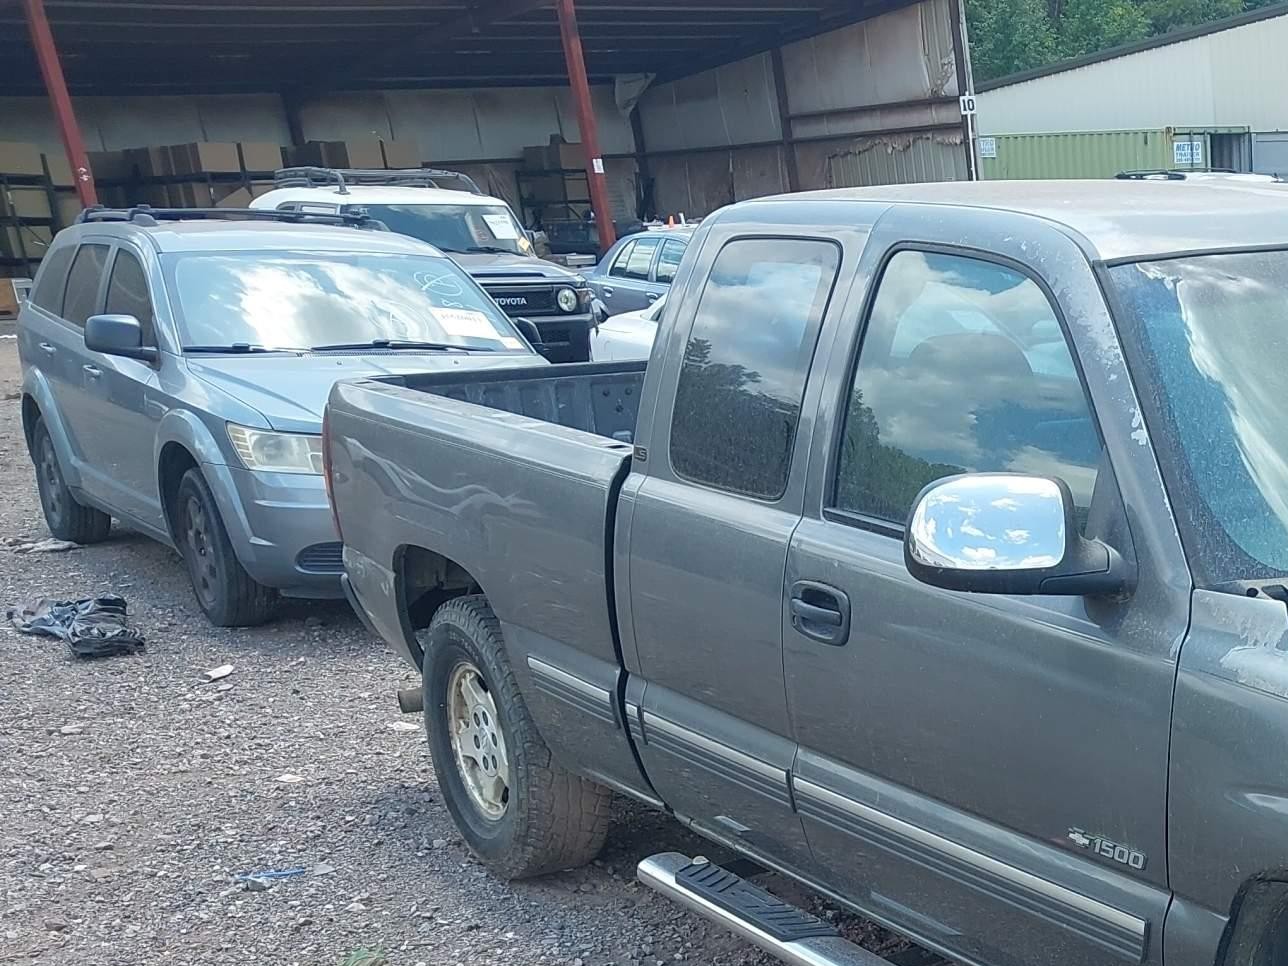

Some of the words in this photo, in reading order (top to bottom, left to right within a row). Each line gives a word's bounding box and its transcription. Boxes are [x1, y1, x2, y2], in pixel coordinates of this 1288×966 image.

[962, 98, 975, 111] 10
[494, 297, 528, 306] TOYOTA
[1094, 838, 1145, 870] 1500
